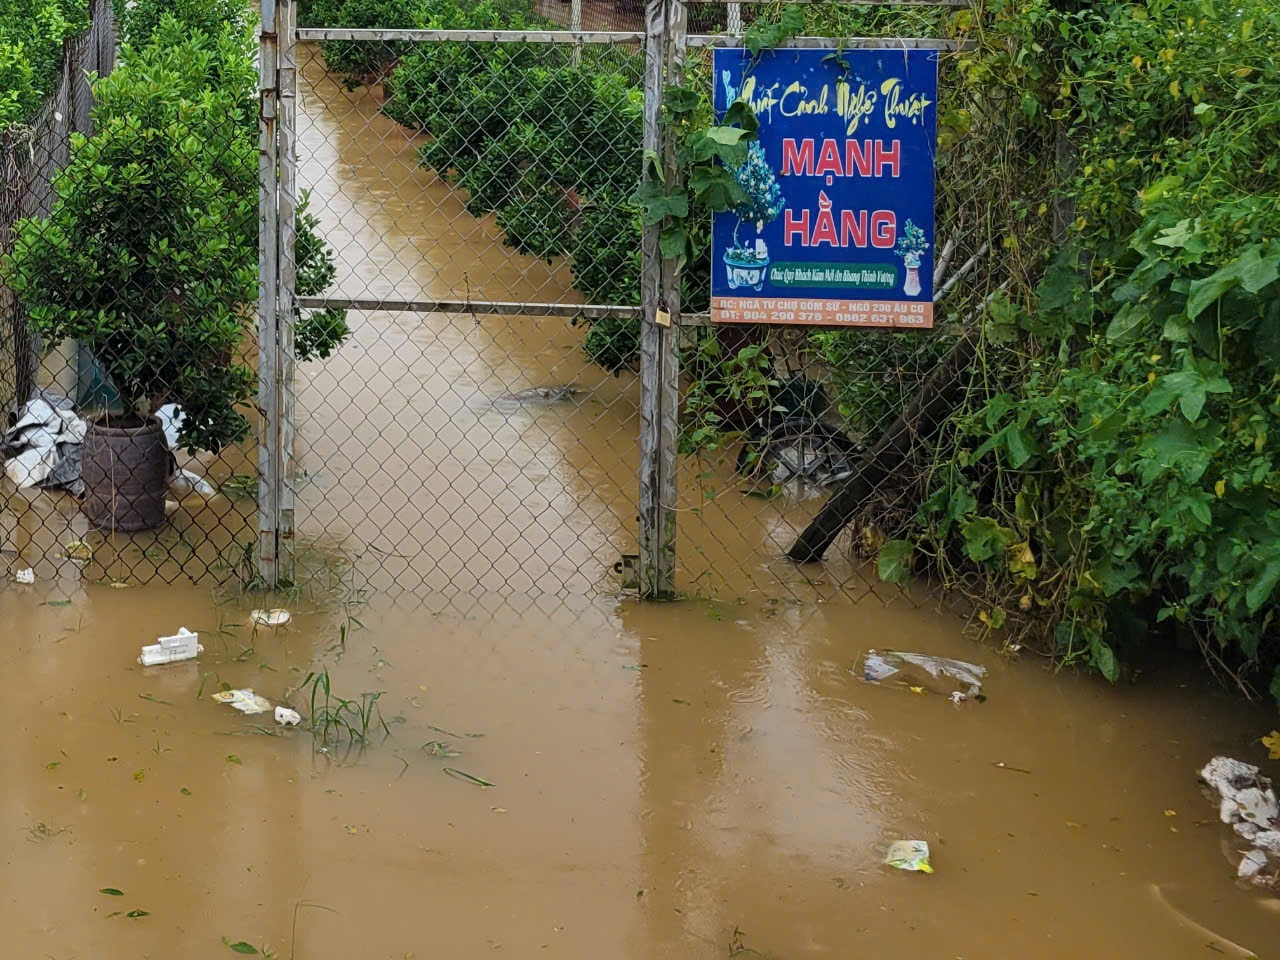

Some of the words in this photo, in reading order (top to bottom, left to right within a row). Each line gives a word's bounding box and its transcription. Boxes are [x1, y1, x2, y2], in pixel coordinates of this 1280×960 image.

[780, 81, 829, 117] Cảnh
[835, 79, 878, 136] Nghệ
[880, 77, 933, 129] Thuật
[782, 138, 900, 185] MẠNH
[784, 190, 897, 249] HẰNG
